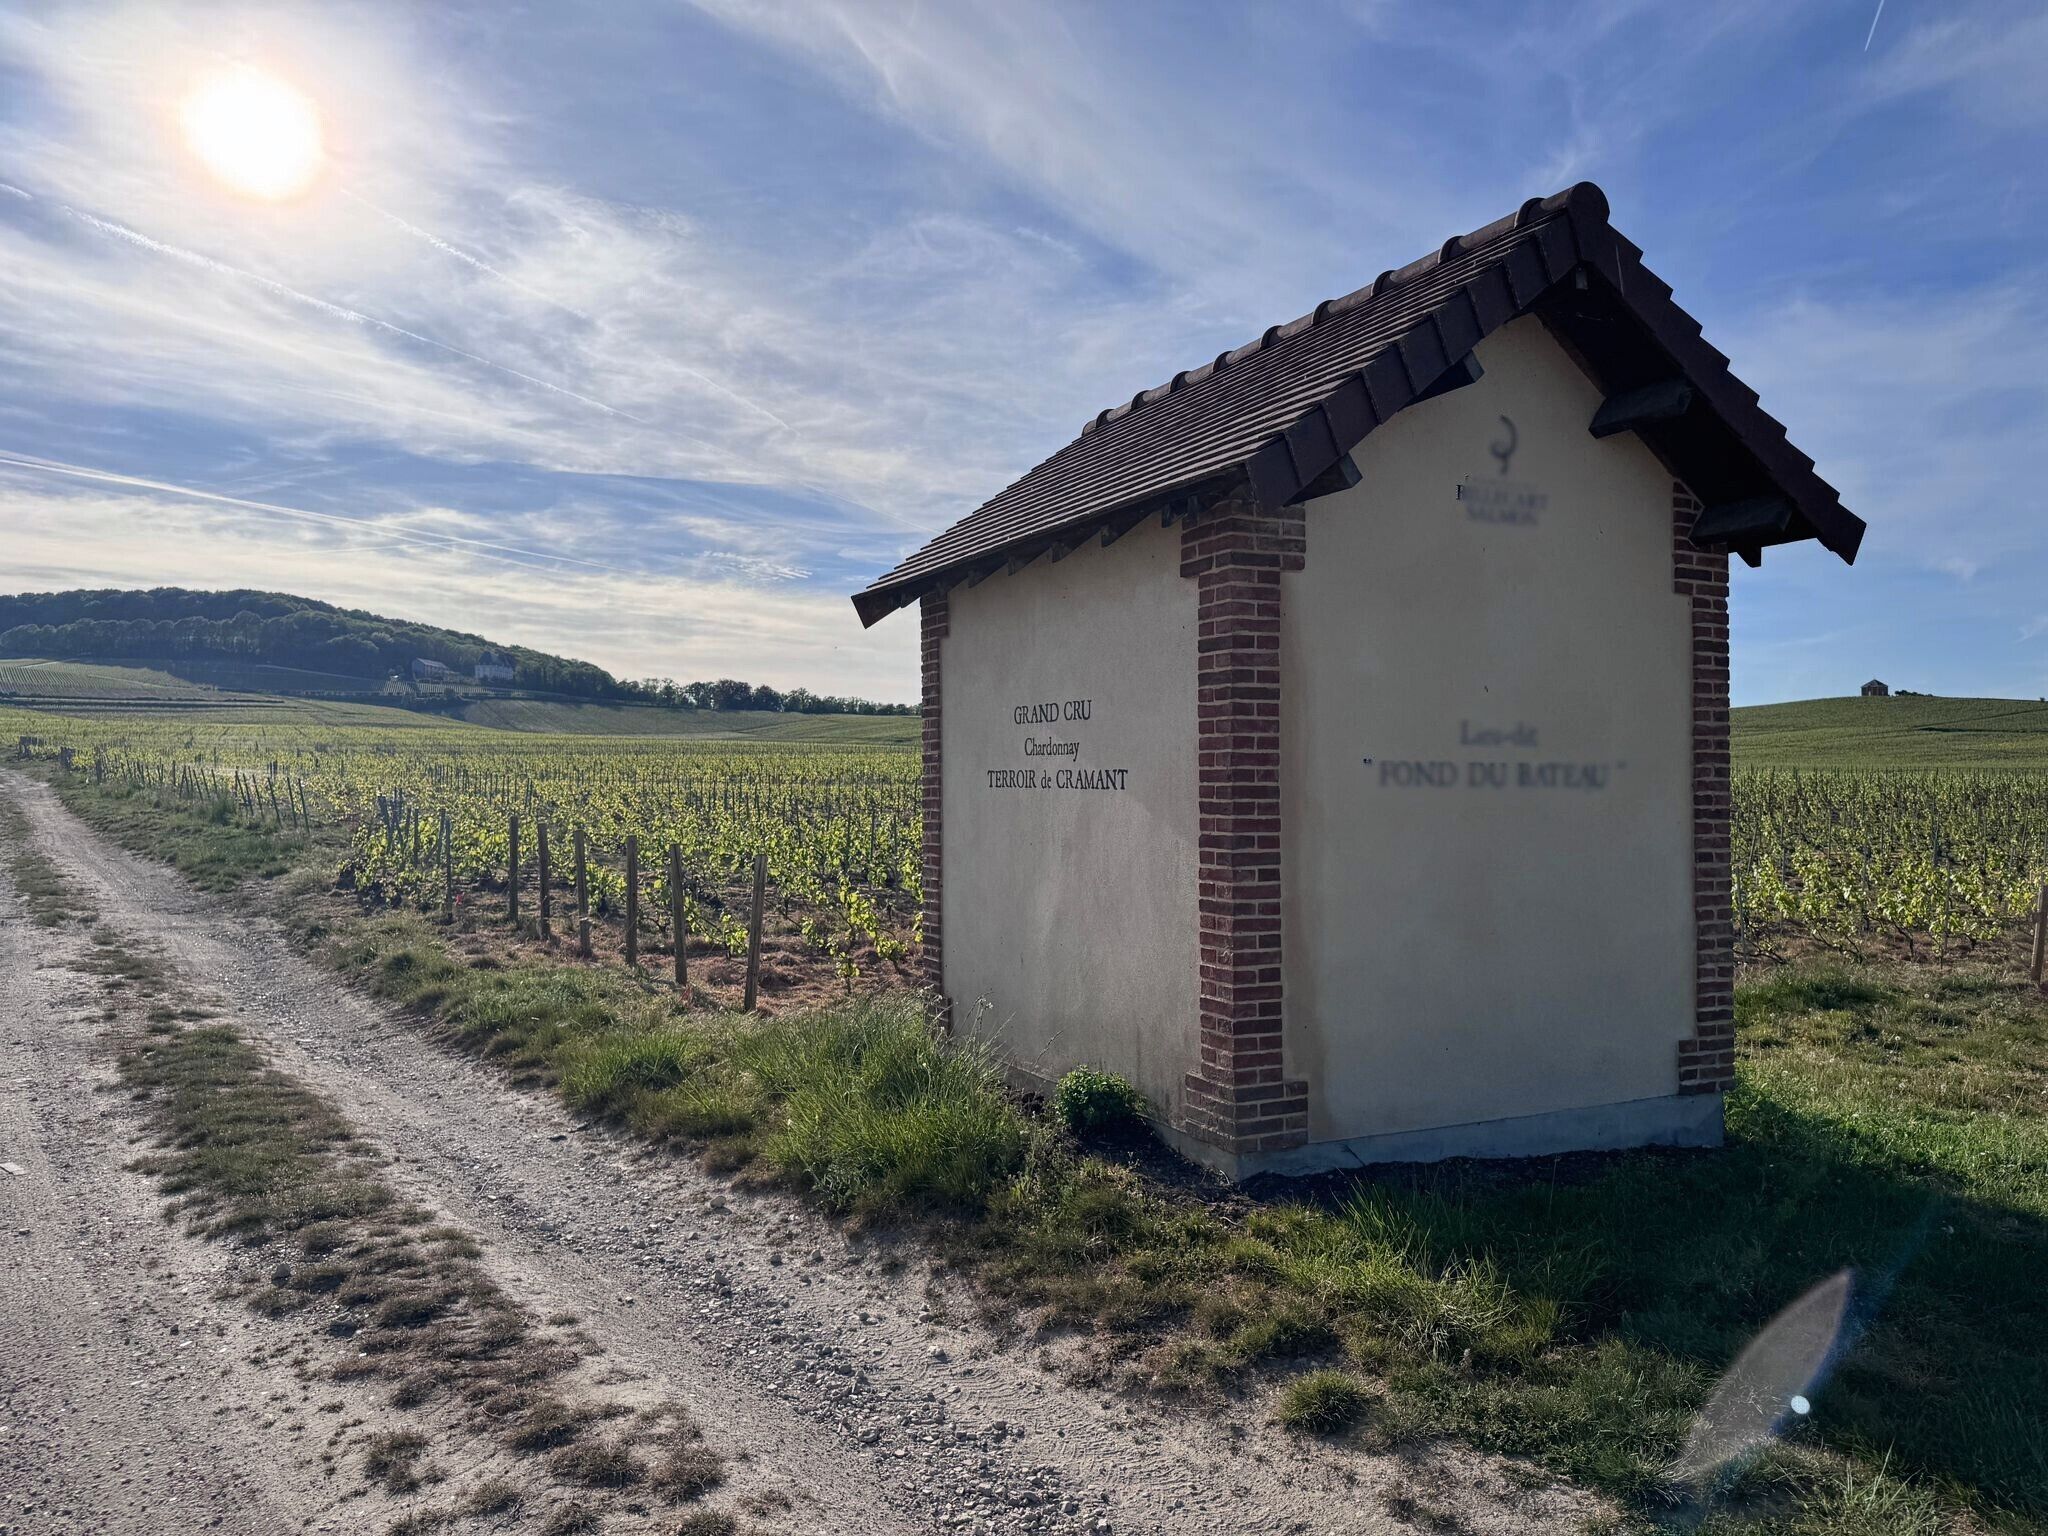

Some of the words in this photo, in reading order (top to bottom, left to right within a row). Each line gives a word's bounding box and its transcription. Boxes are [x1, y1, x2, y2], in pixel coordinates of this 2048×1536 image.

[1014, 703, 1059, 724] GRAND
[1064, 700, 1092, 721] CRU
[1024, 737, 1080, 762] Chardonnay
[987, 770, 1037, 788] TERROIR
[1041, 770, 1051, 789] de
[1056, 769, 1128, 790] CRAMANT
[1467, 761, 1507, 788] DU
